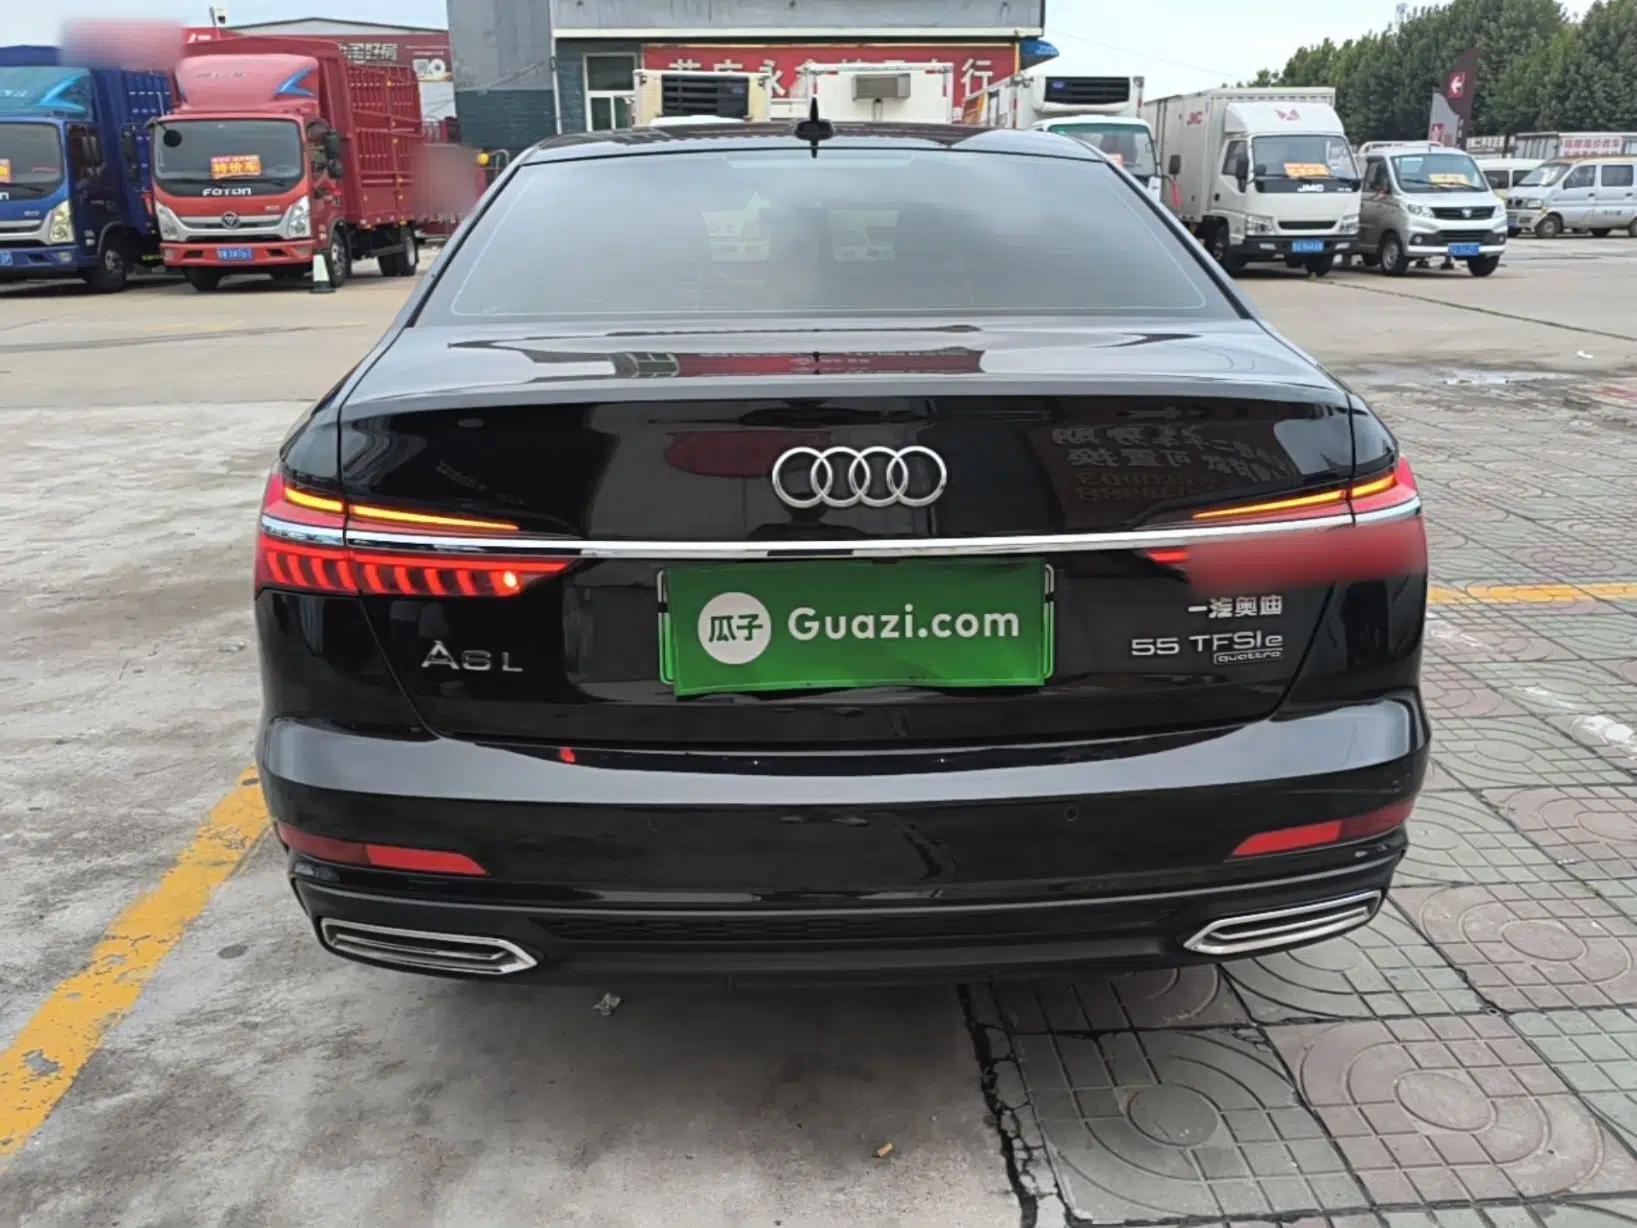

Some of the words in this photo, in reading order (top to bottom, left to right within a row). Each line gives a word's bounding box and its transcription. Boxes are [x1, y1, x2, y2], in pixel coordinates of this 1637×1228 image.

[202, 187, 252, 197] FOTON
[1188, 595, 1282, 618] 一汽奥迪
[708, 613, 763, 642] 瓜子
[787, 603, 1020, 641] Guazi.com
[1131, 636, 1180, 656] 55
[1217, 650, 1282, 663] quattro
